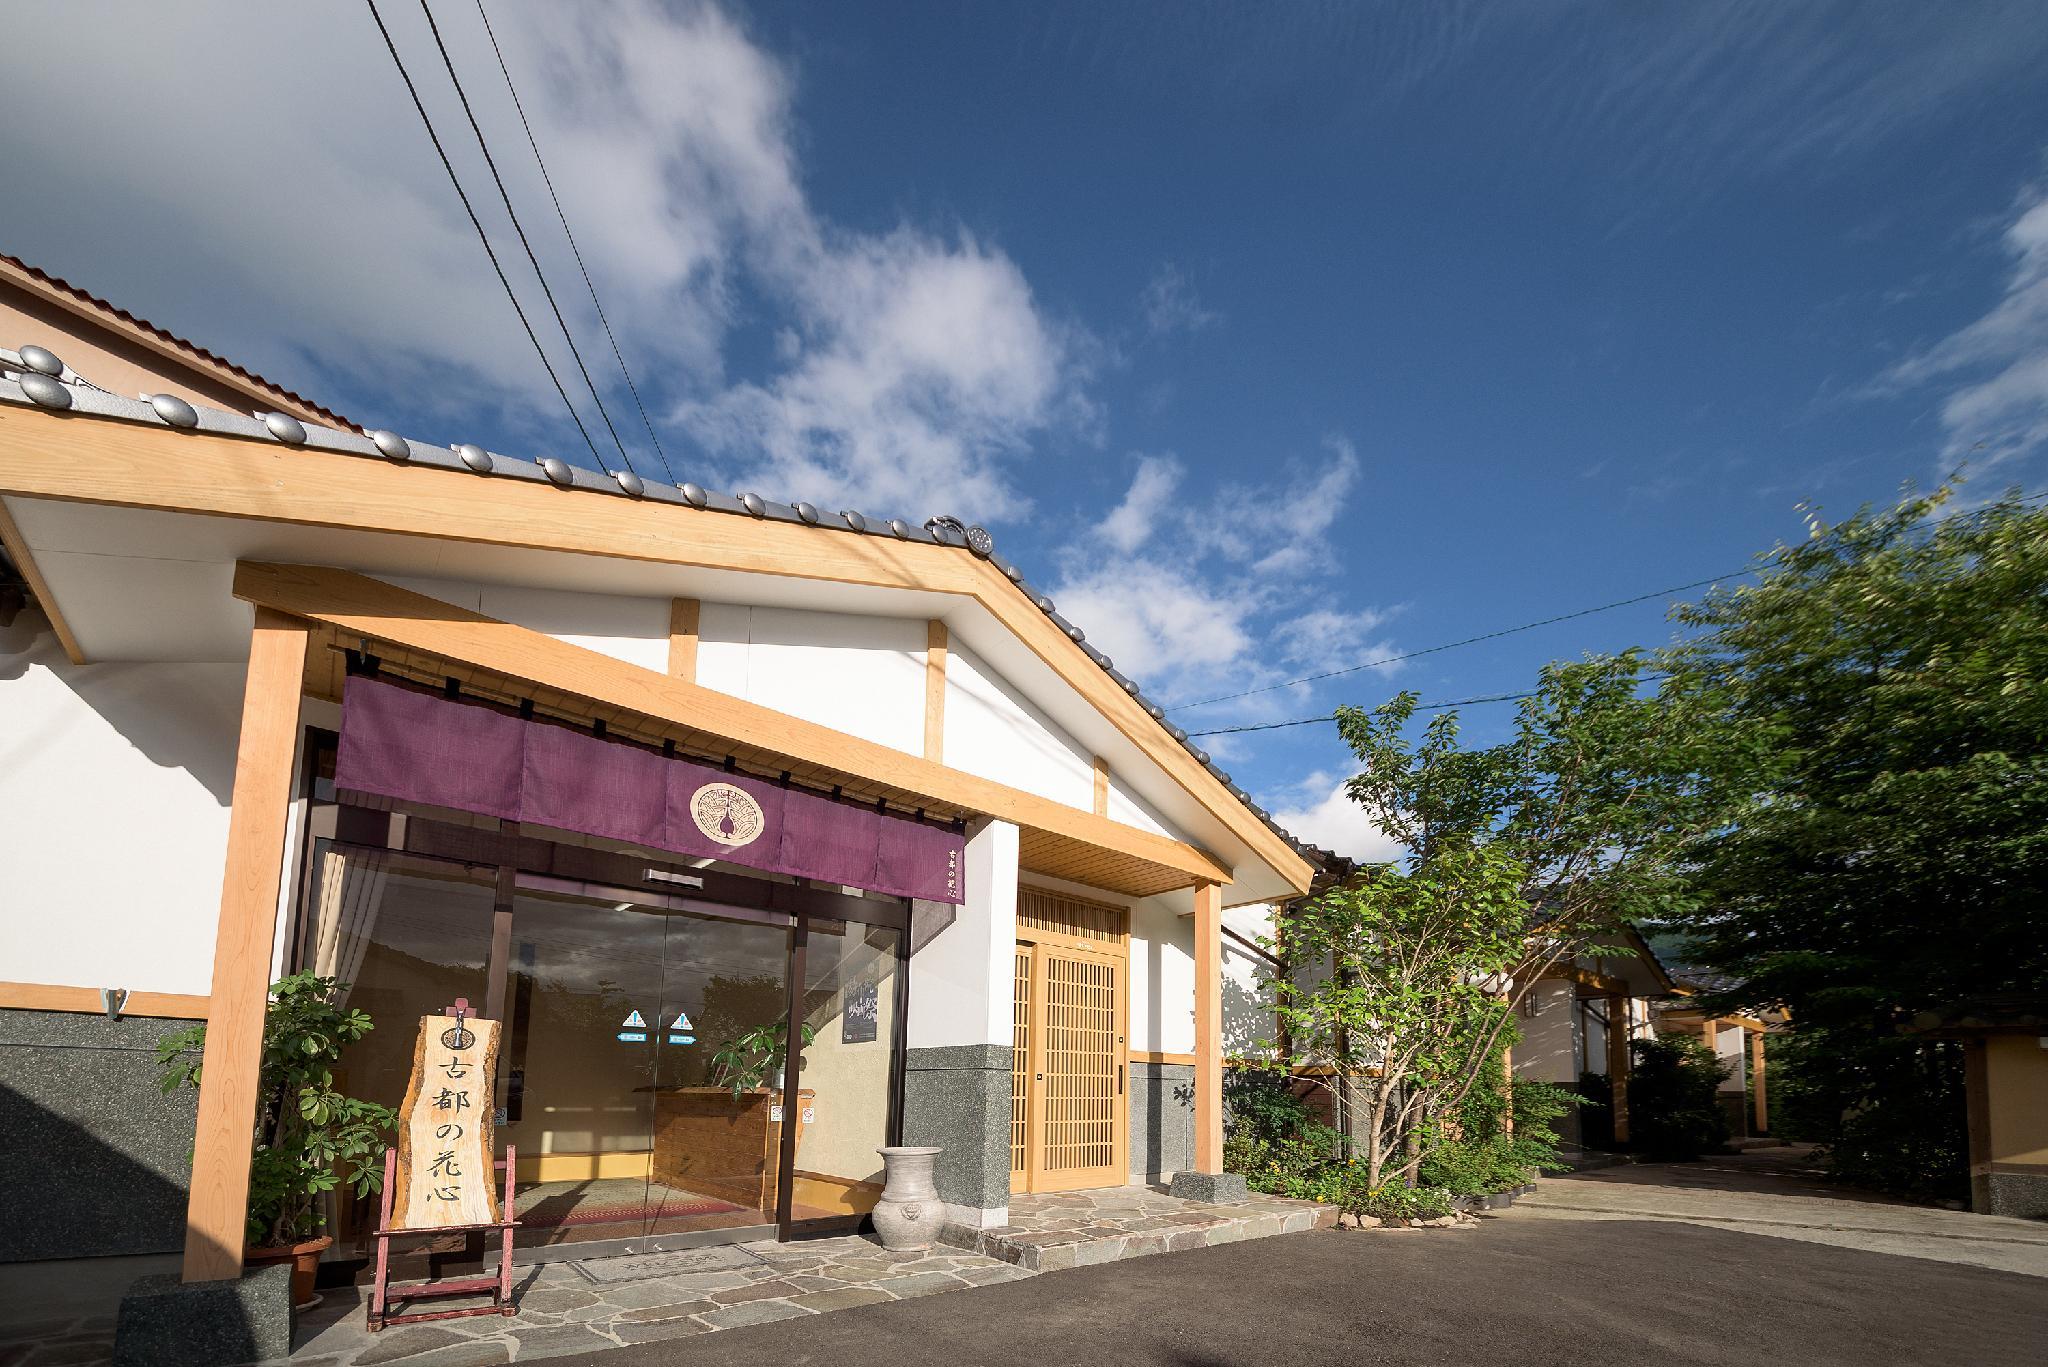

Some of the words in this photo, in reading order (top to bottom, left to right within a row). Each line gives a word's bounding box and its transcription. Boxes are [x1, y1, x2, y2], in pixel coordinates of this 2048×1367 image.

[426, 1056, 474, 1202] 古都の花心
